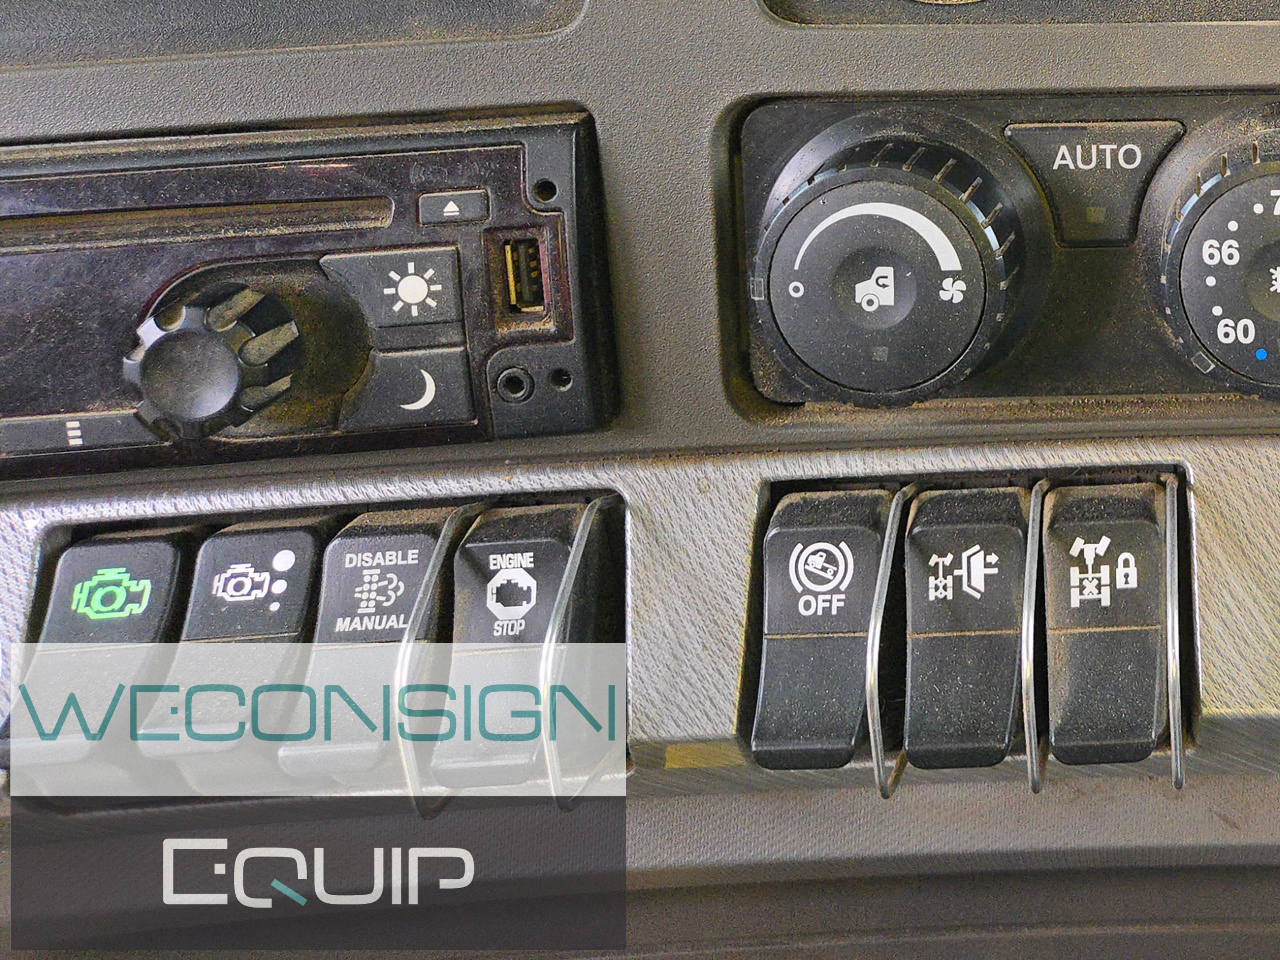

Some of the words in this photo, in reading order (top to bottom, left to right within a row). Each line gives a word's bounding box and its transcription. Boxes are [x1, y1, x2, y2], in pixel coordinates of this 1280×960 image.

[1053, 144, 1142, 170] AUTO
[1202, 239, 1241, 266] 66
[1216, 318, 1256, 345] 60
[345, 549, 419, 568] DISABLE
[489, 551, 535, 570] ENGINE
[798, 594, 846, 617] OFF
[334, 613, 409, 633] MANUAL
[493, 619, 526, 637] STOP
